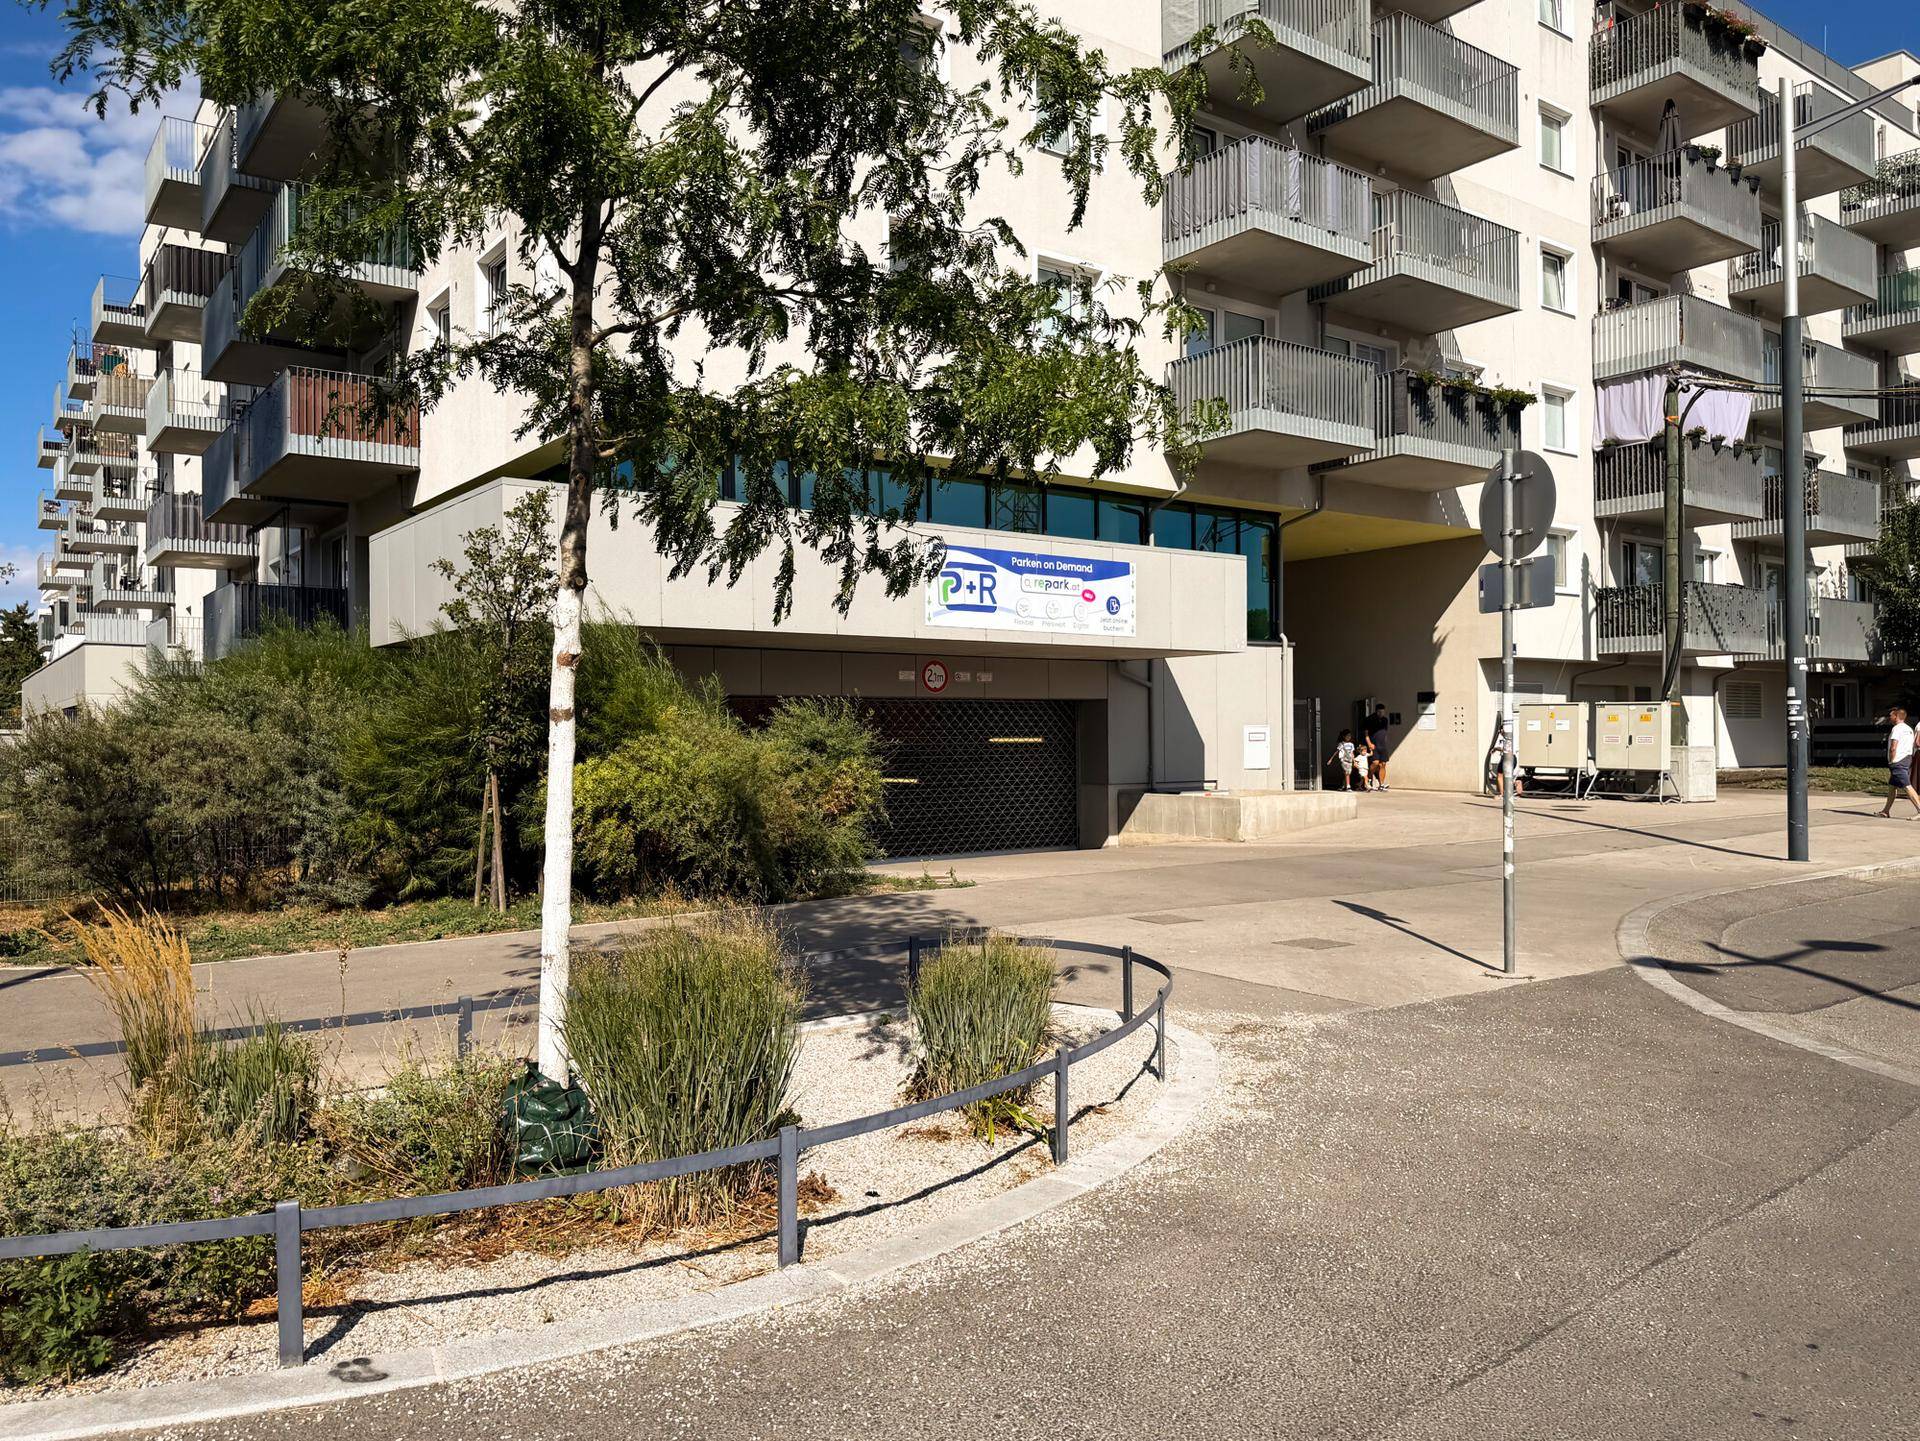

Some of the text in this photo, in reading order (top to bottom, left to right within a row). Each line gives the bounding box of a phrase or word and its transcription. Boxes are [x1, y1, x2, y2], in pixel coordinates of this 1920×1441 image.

[1011, 557, 1093, 573] Parken on Demand
[940, 570, 997, 605] P+R
[1034, 578, 1080, 591] repark.at
